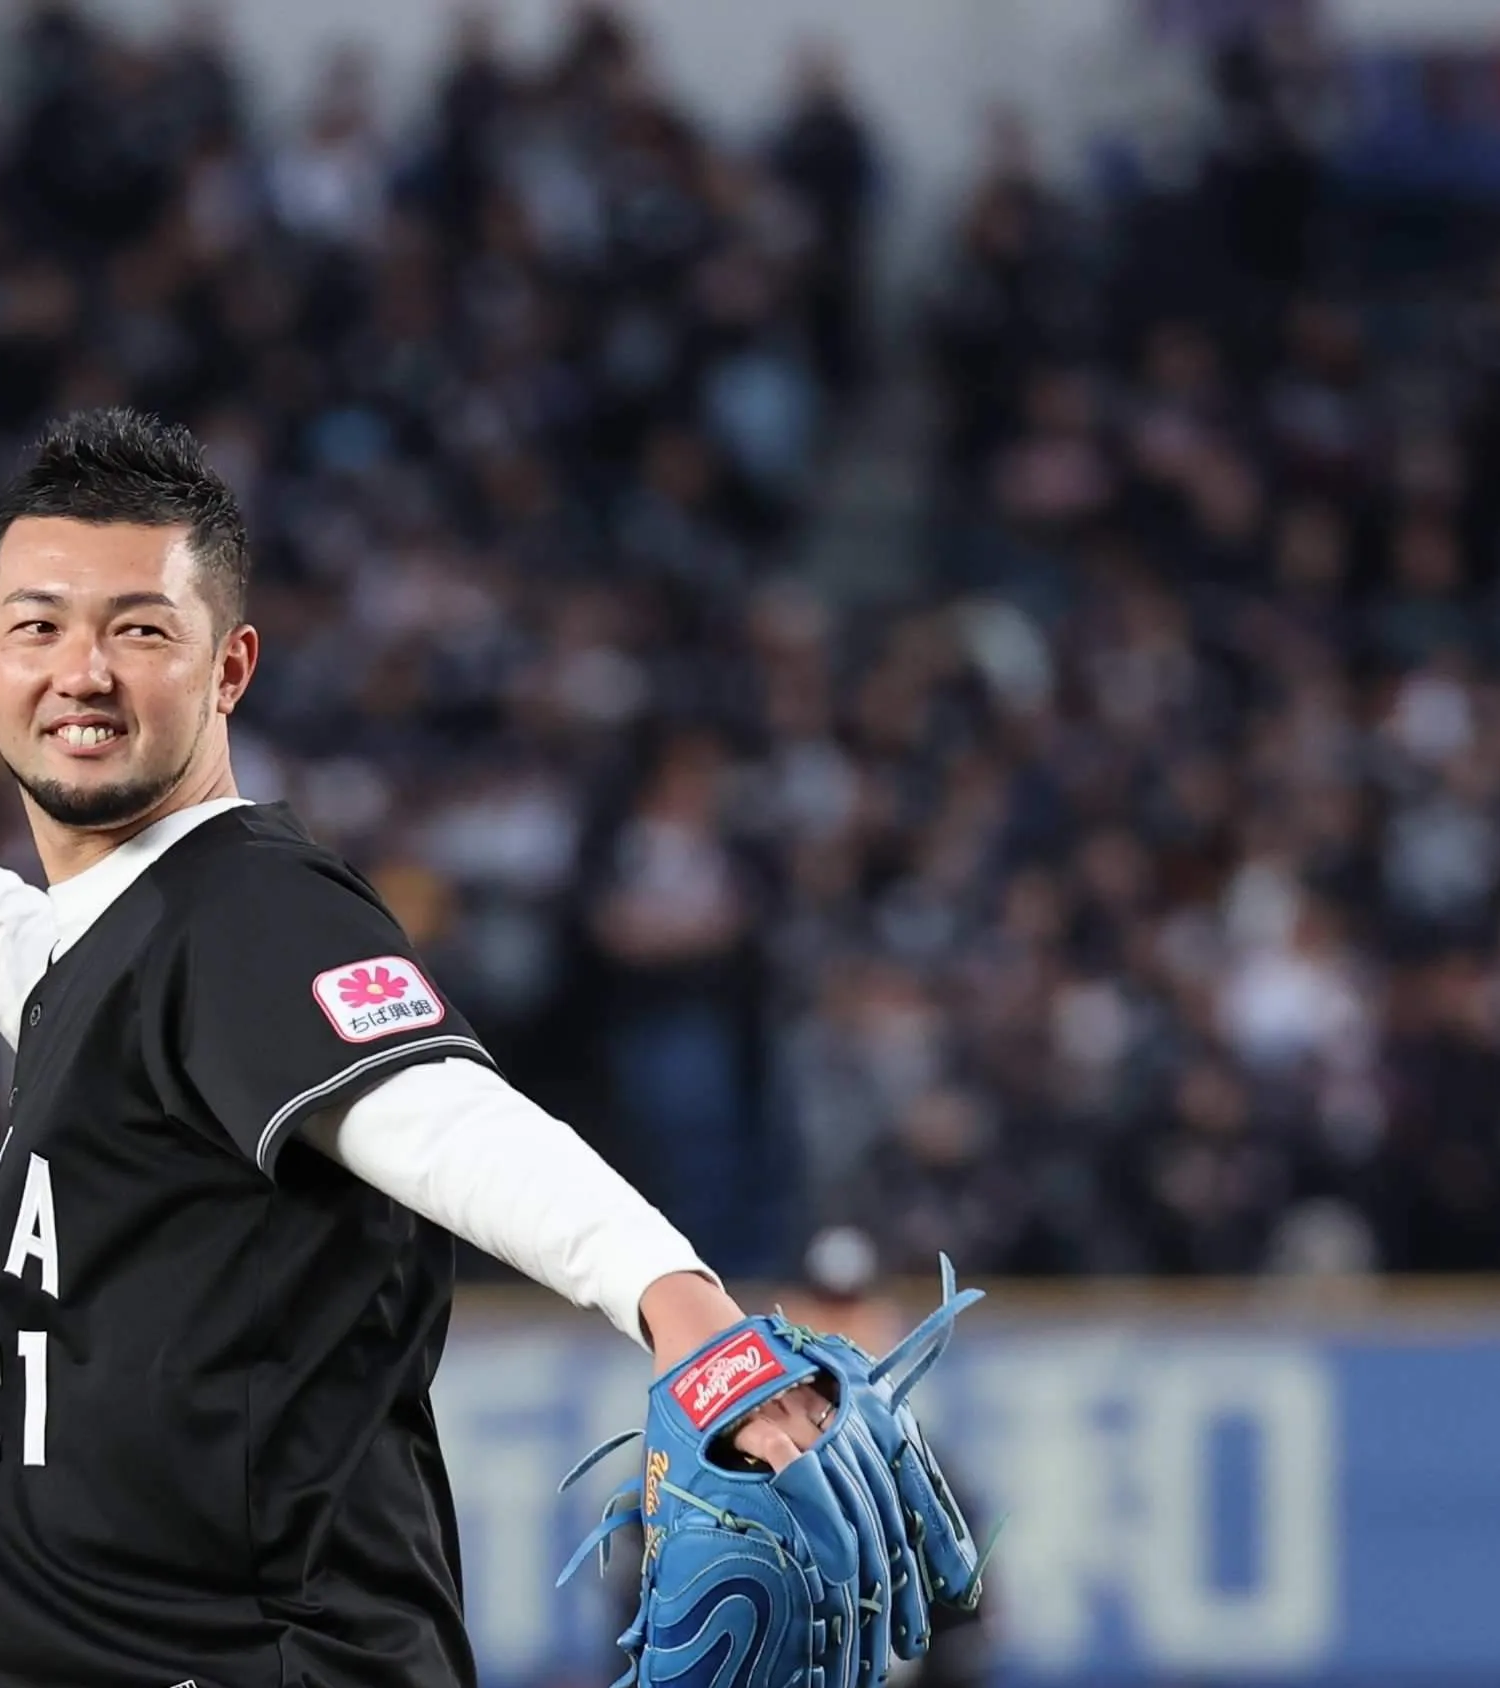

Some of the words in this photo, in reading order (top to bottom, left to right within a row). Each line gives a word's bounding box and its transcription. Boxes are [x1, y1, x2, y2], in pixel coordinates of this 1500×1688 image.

[349, 1000, 434, 1033] ちば興銀
[693, 1345, 761, 1411] Rawlings
